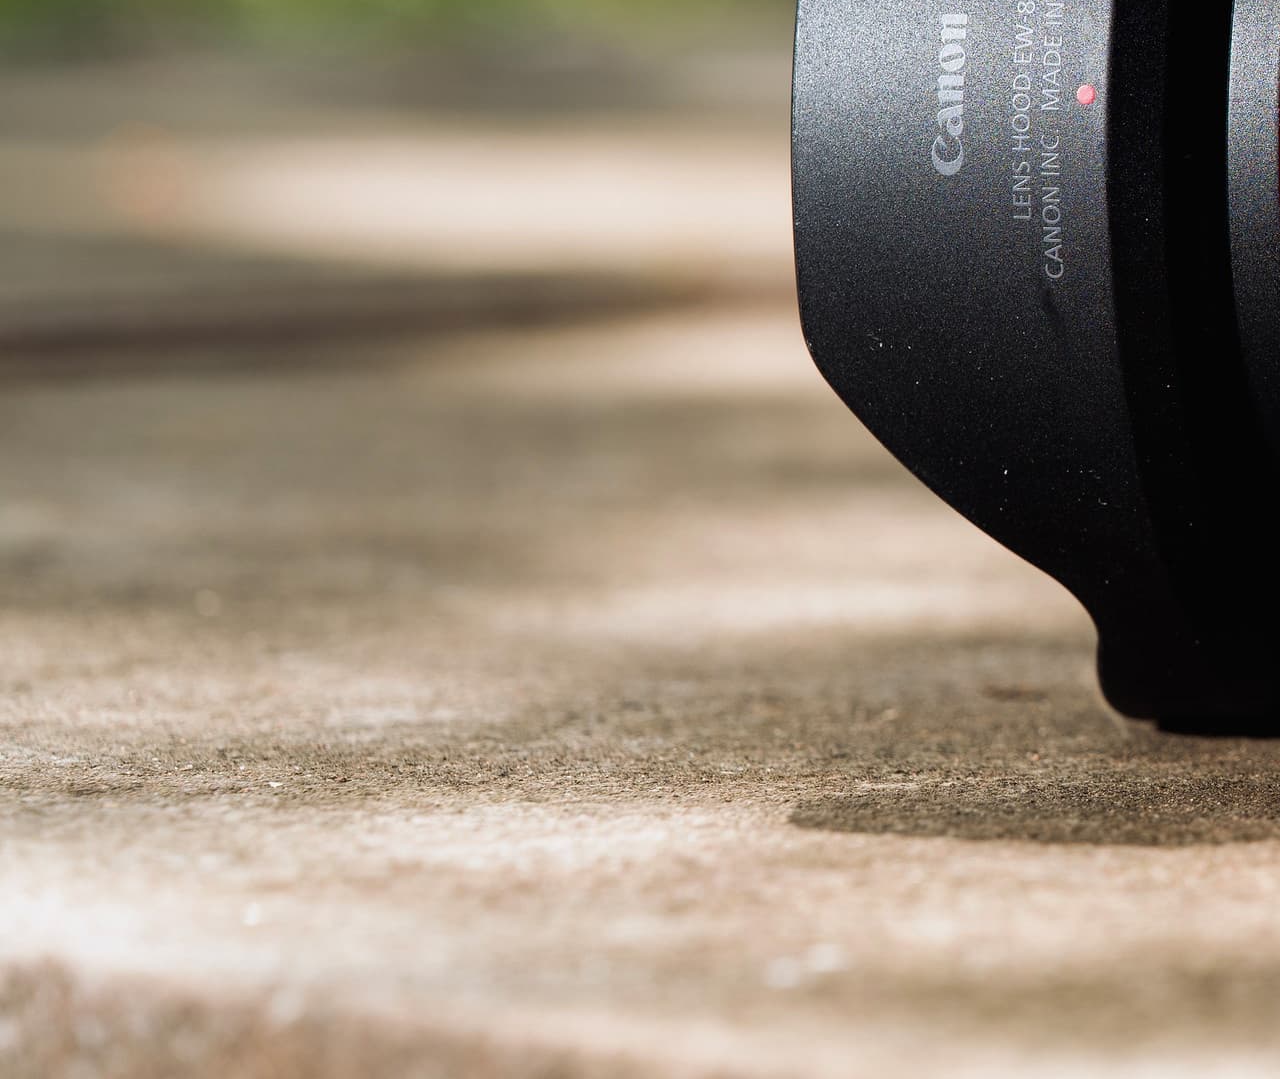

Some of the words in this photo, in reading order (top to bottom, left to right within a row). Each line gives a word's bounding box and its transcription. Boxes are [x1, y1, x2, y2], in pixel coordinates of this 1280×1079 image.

[1045, 0, 1066, 26] IN
[931, 13, 968, 177] Canon
[1012, 73, 1033, 152] HOOD
[1041, 35, 1064, 112] MADE
[1012, 161, 1033, 221] LENS
[1040, 185, 1065, 281] CANON
